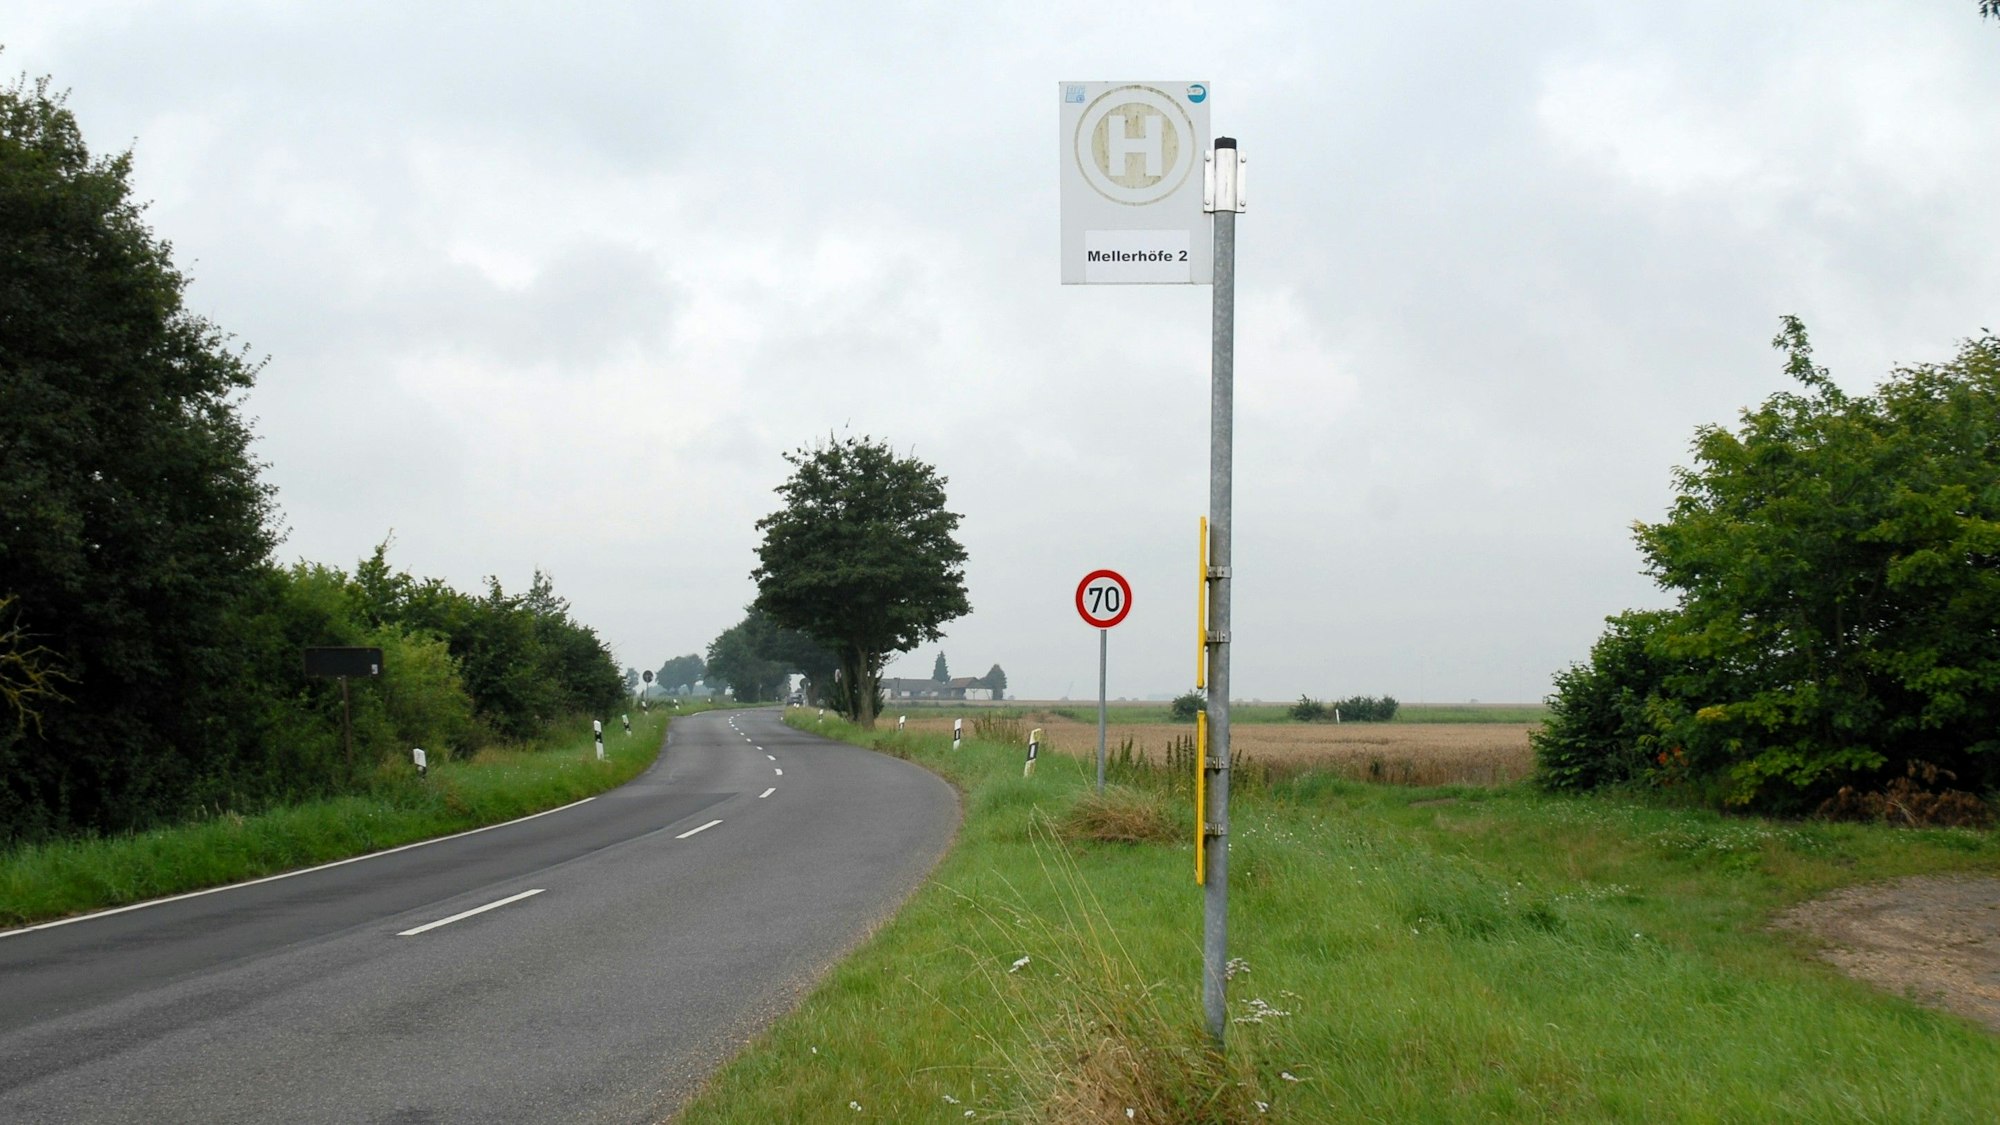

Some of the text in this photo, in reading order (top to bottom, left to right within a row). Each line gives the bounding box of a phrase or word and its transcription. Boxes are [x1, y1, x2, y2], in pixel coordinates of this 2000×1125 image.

[1108, 115, 1162, 177] H
[1087, 250, 1188, 262] Mellerhöfe 2
[1089, 586, 1120, 613] 70
